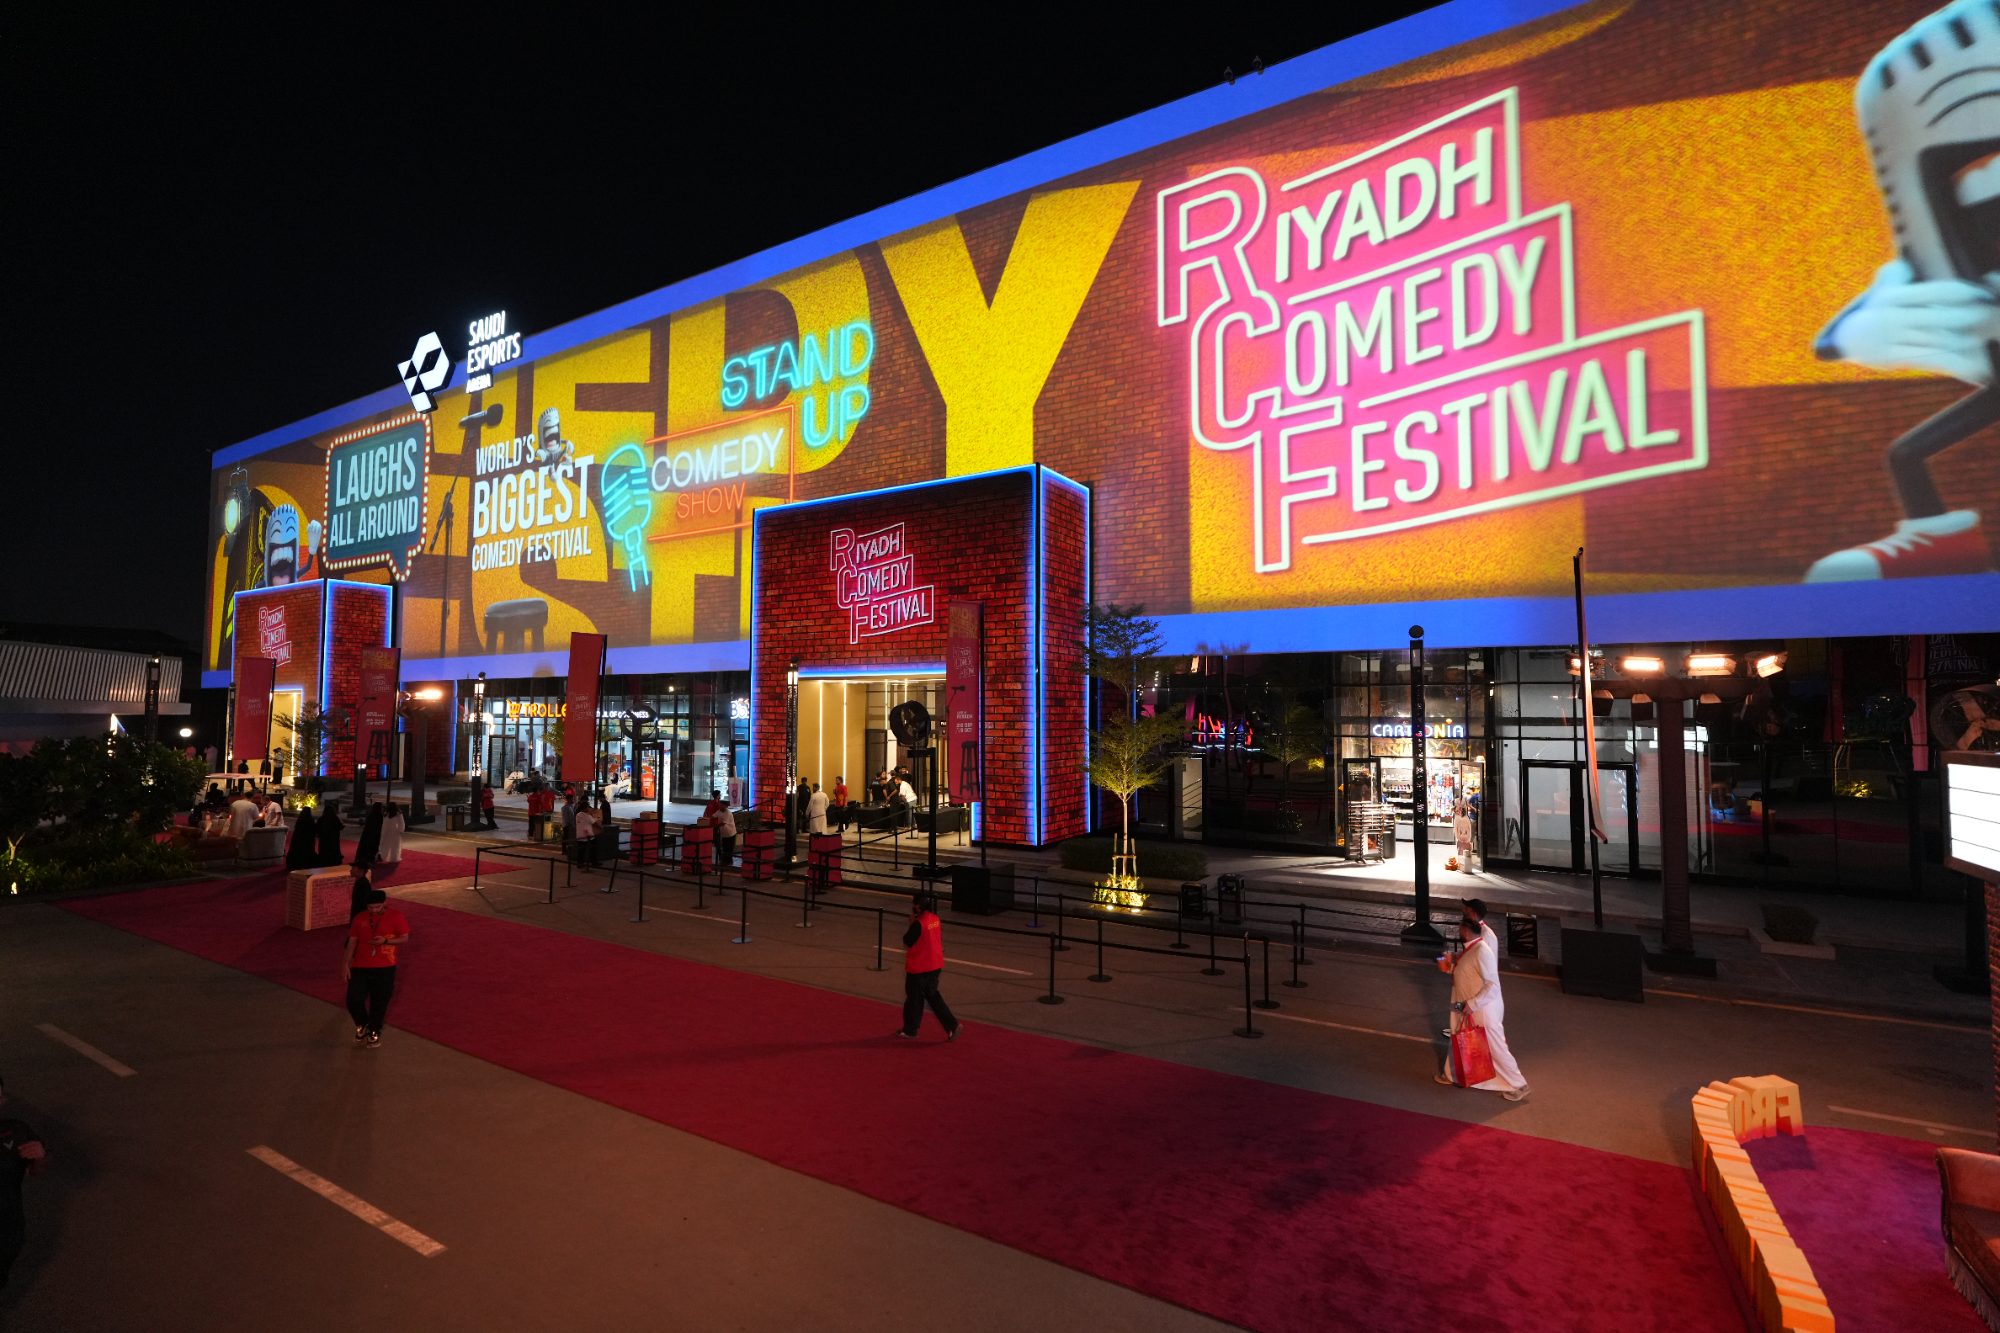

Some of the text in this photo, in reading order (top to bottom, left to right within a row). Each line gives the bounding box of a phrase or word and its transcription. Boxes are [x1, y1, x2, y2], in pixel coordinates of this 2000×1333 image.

[1156, 125, 1494, 328] RIYADH
[466, 332, 521, 374] ESPORTS
[468, 310, 506, 346] SAUDI
[1190, 234, 1547, 452] COMEDY
[721, 321, 876, 408] STAND
[802, 383, 871, 448] UP
[335, 437, 418, 508] LAUGHS
[475, 433, 536, 476] WORLD'S
[651, 427, 785, 492] COMEDY
[1252, 347, 1680, 574] FESTIVAL
[329, 495, 419, 548] ALL AROUND
[472, 454, 595, 539] BIGGEST
[676, 480, 747, 519] SHOW
[471, 525, 592, 572] COMEDY FESTIVAL
[830, 528, 900, 572] RIYADH
[837, 561, 909, 609] COMEDY
[850, 592, 930, 644] FESTIVAL
